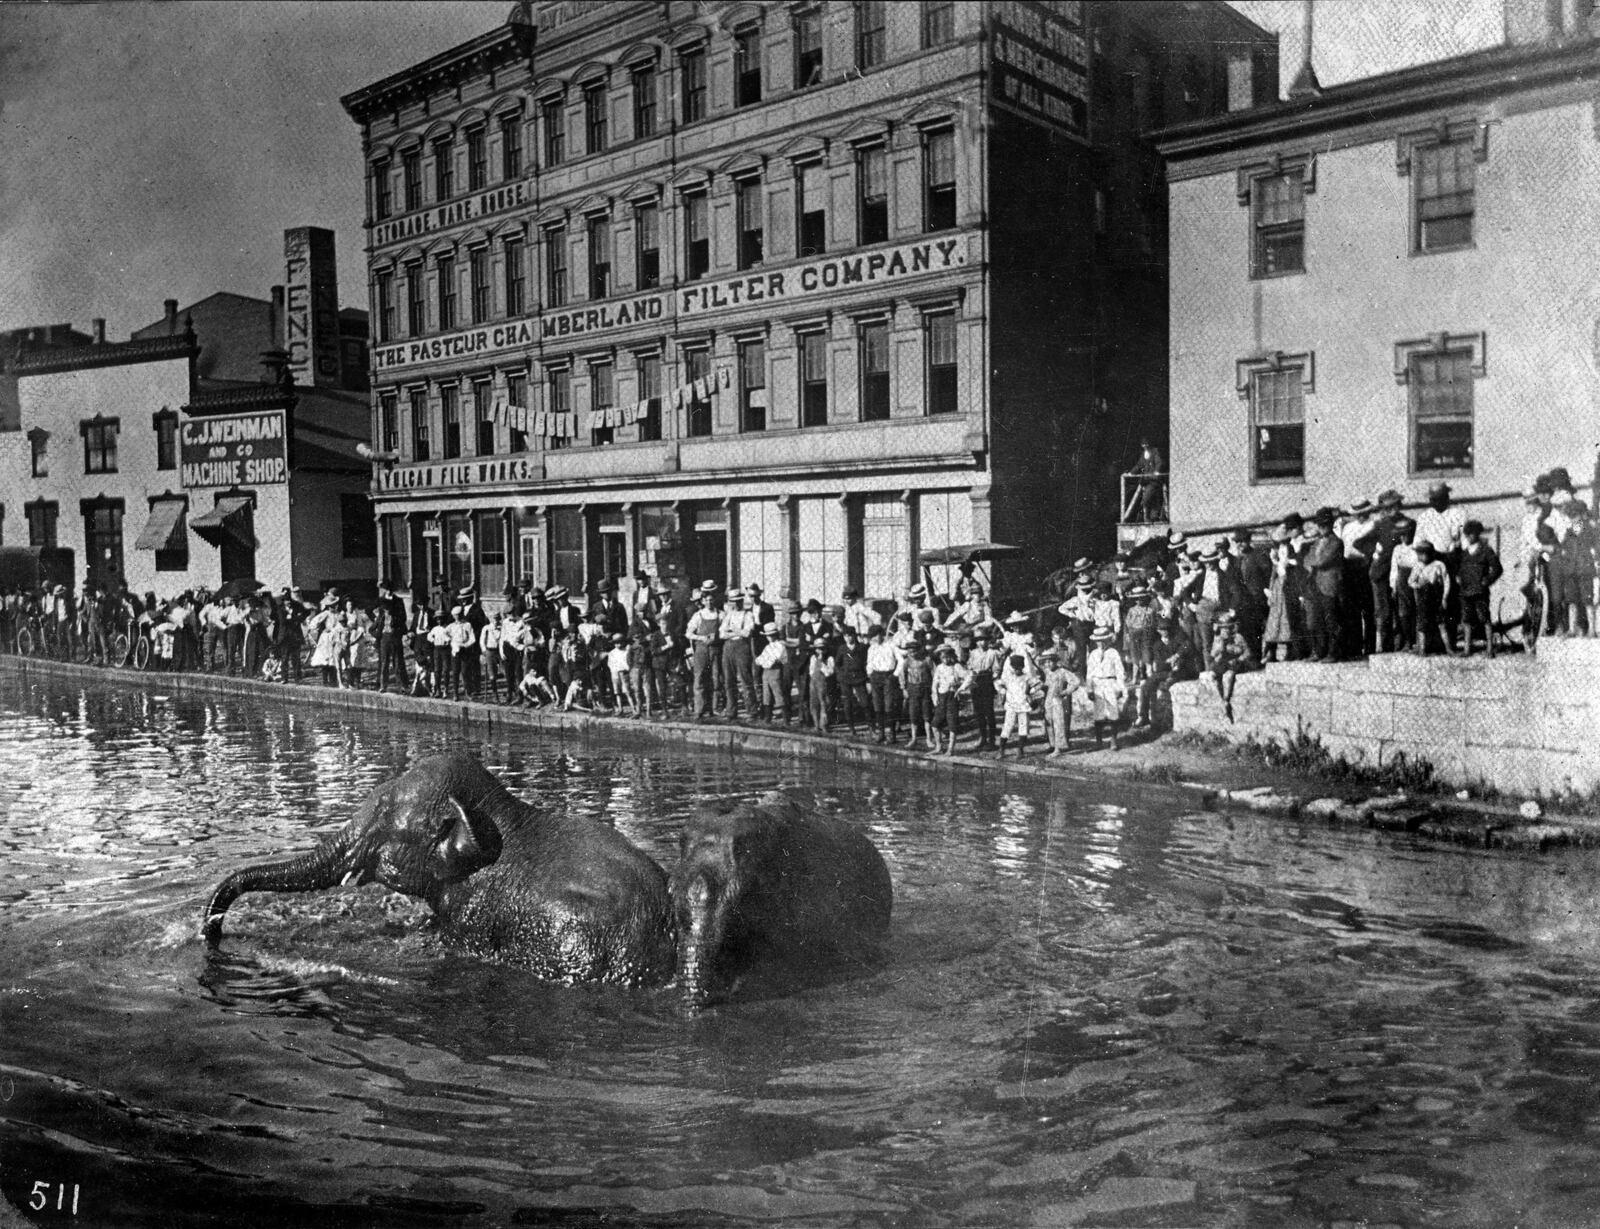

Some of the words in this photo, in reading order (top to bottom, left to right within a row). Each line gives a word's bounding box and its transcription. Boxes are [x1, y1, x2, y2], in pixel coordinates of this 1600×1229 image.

[376, 347, 406, 367] THE
[410, 331, 488, 362] PASTEUR
[682, 272, 785, 312] FILTER
[209, 446, 227, 458] AND
[236, 444, 253, 456] CO
[182, 460, 242, 487] MACHINE
[384, 467, 432, 489] VULCAN
[441, 465, 470, 485] FILE
